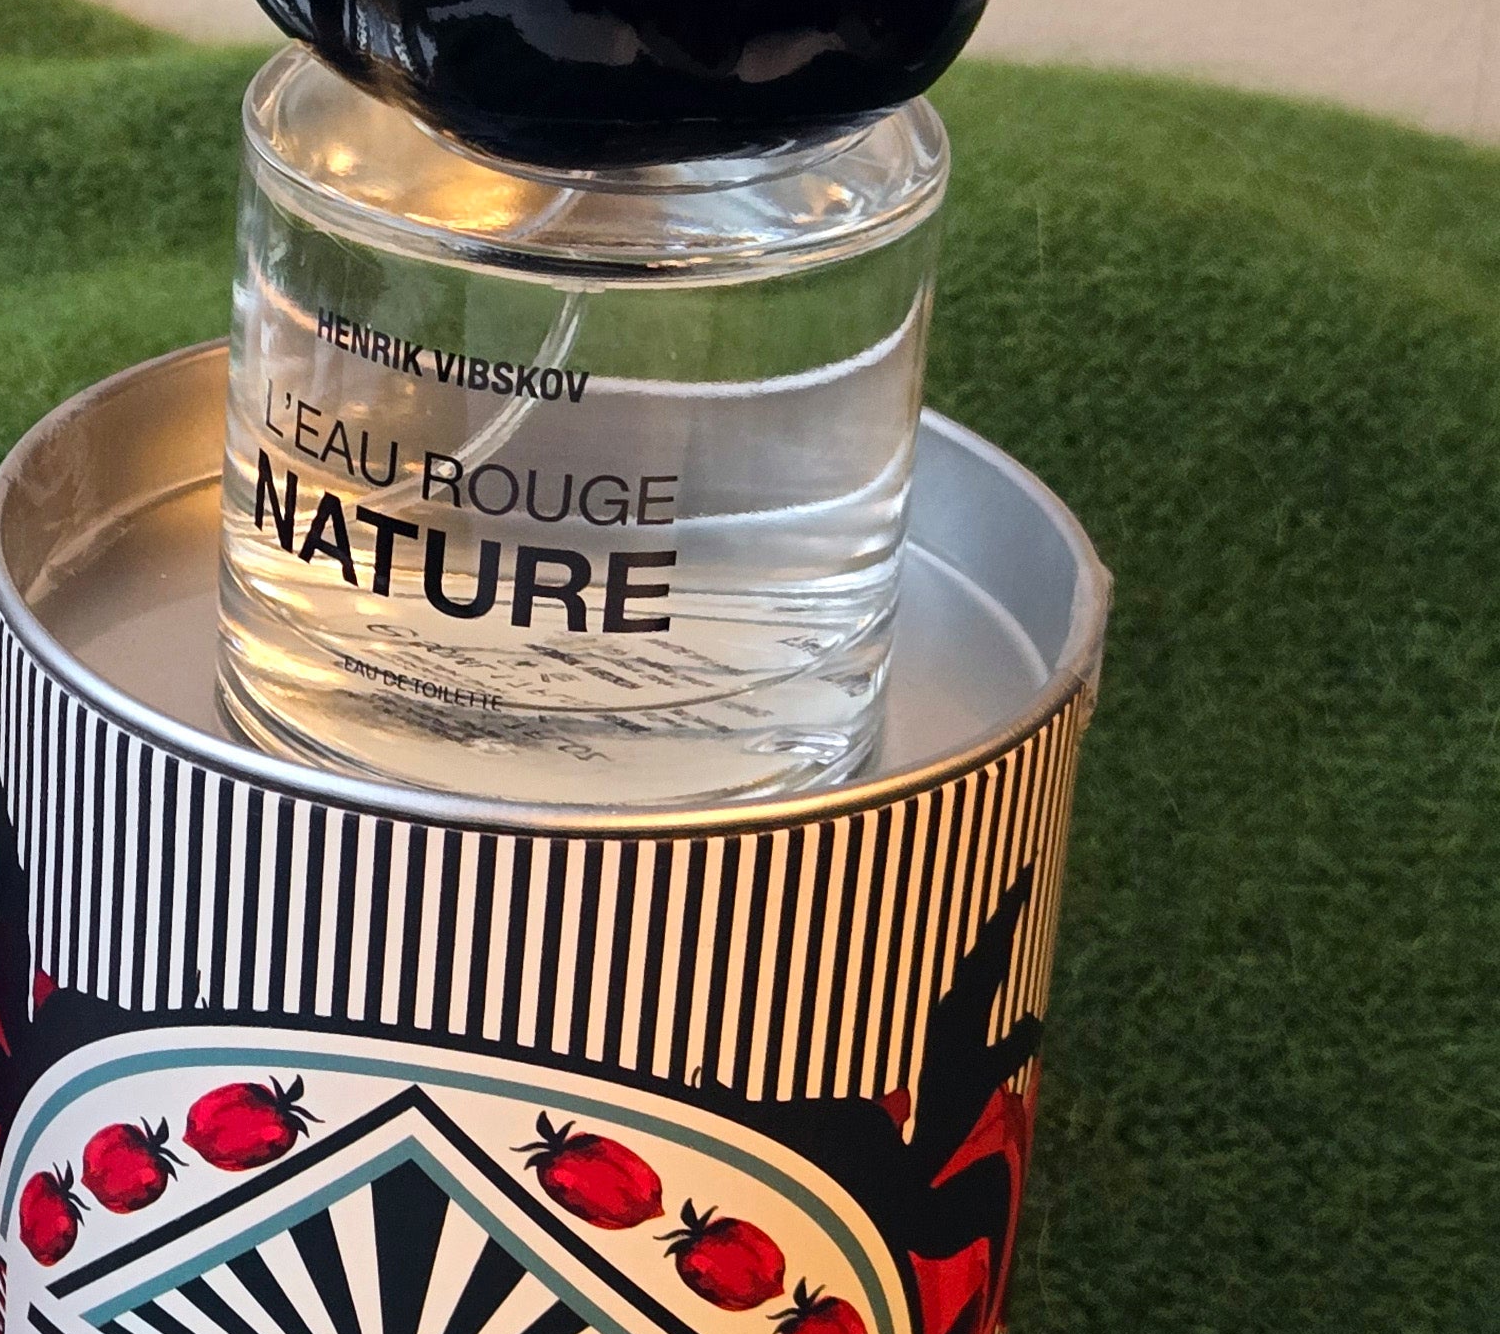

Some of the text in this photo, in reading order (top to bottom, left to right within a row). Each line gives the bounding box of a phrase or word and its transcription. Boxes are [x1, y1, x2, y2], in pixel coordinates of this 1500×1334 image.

[317, 307, 589, 403] HENRIK VIBSKOV
[422, 451, 678, 526] ROUGE
[254, 448, 677, 634] NATURE
[343, 655, 502, 712] EAU DE TOILETTE
